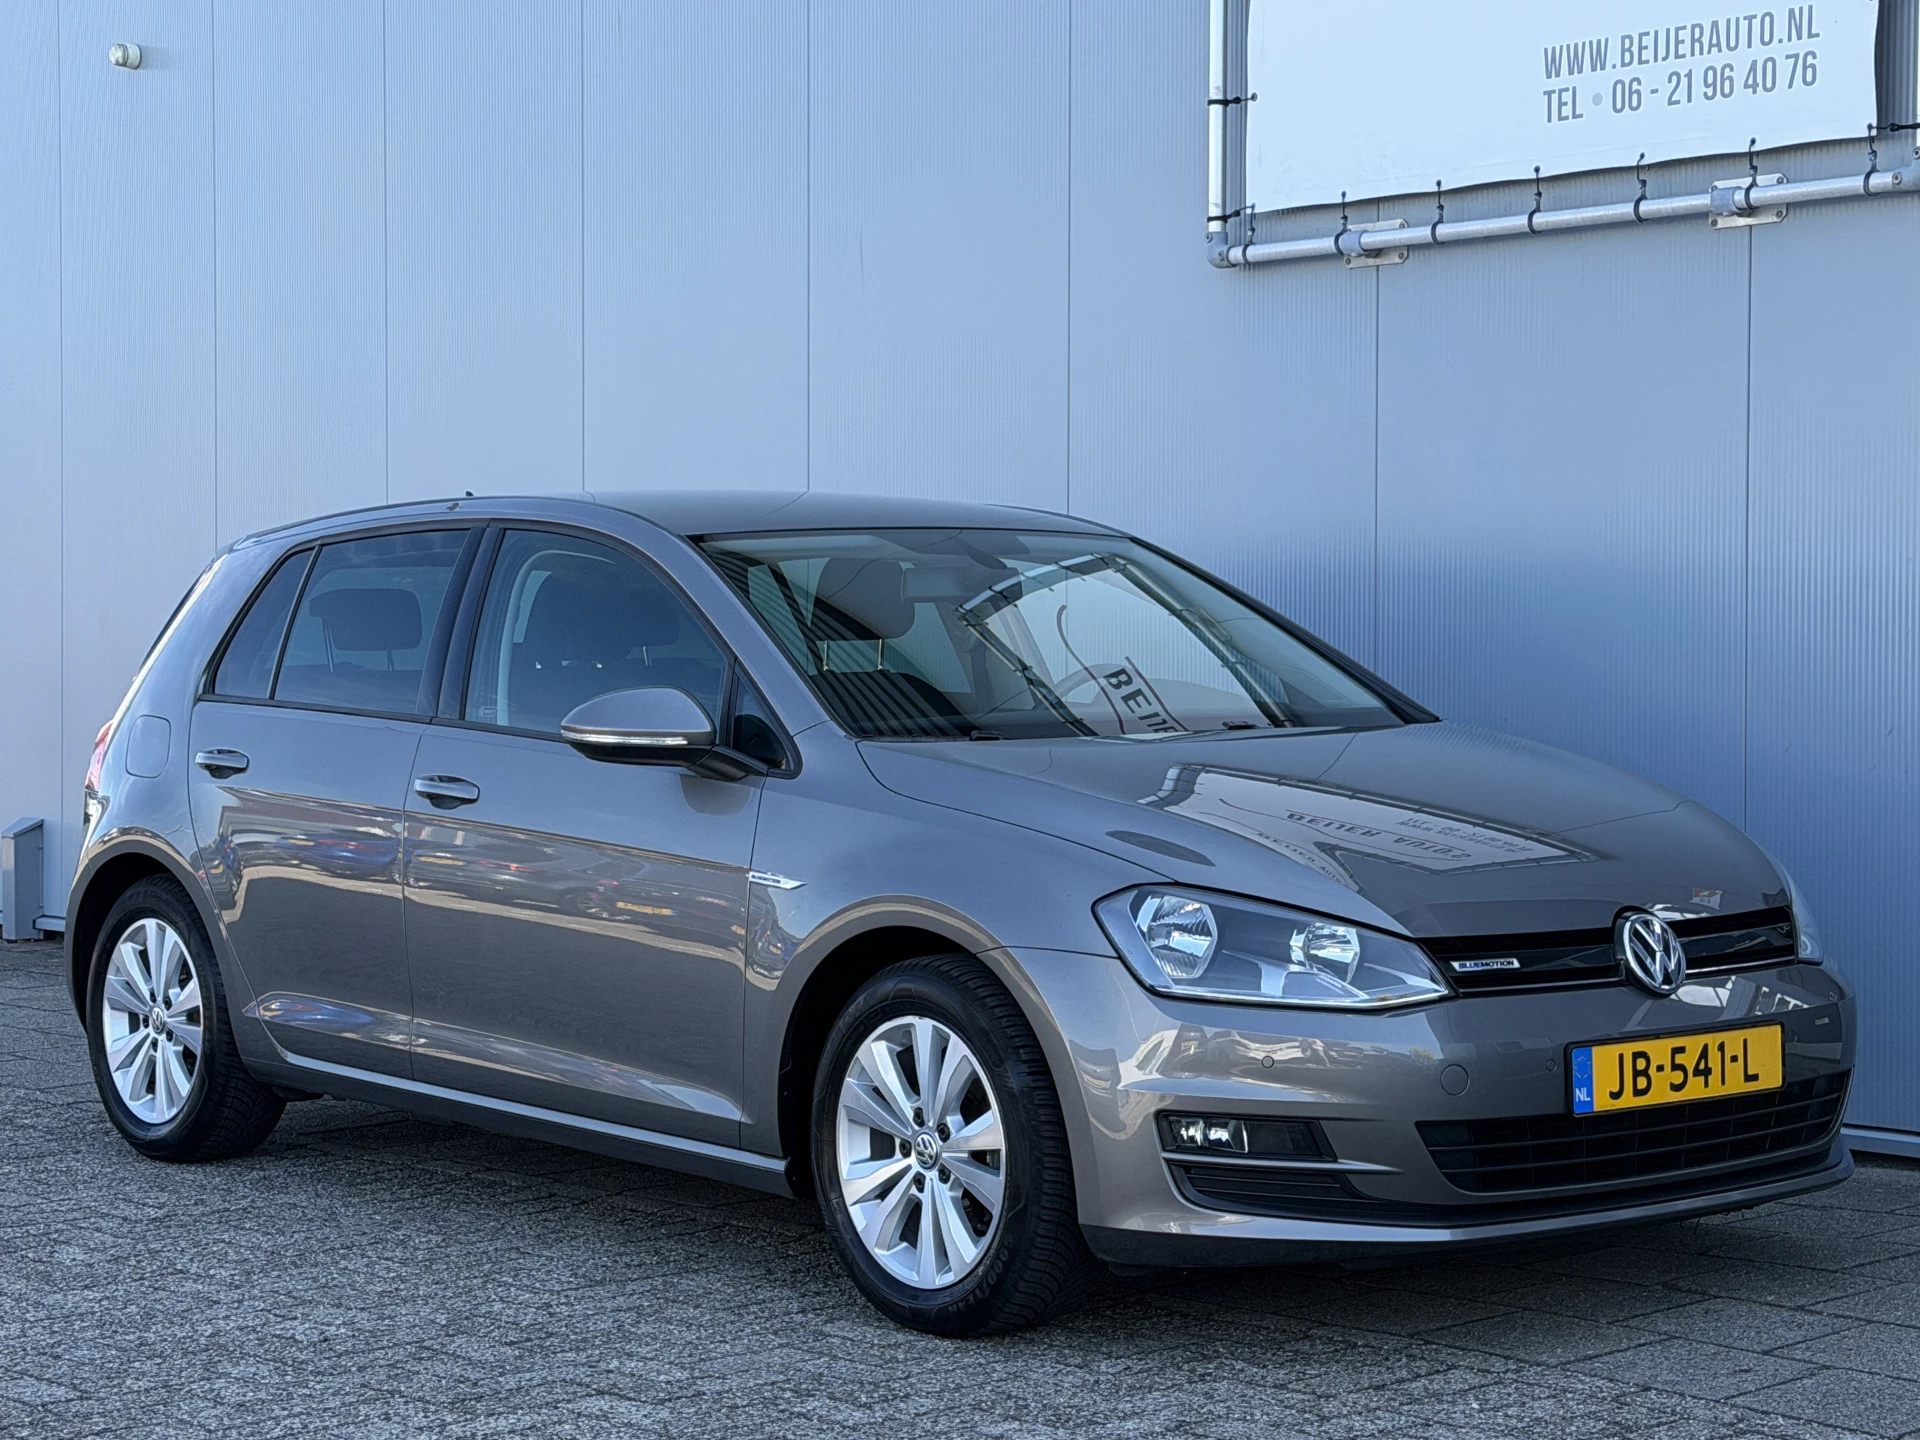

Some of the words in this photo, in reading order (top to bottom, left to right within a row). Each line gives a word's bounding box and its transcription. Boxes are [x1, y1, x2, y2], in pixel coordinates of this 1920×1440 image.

[1543, 4, 1821, 80] WWW.BEIJERAUTO.NL
[1543, 86, 1584, 123] TEL
[1612, 76, 1642, 114] 06
[1667, 68, 1693, 106] 21
[1703, 63, 1735, 101] 96
[1743, 56, 1778, 95] 40
[1784, 50, 1818, 90] 76
[1458, 959, 1515, 970] BLUEMOTION
[1575, 1087, 1591, 1103] NL
[1608, 1037, 1760, 1101] JB-541-L
